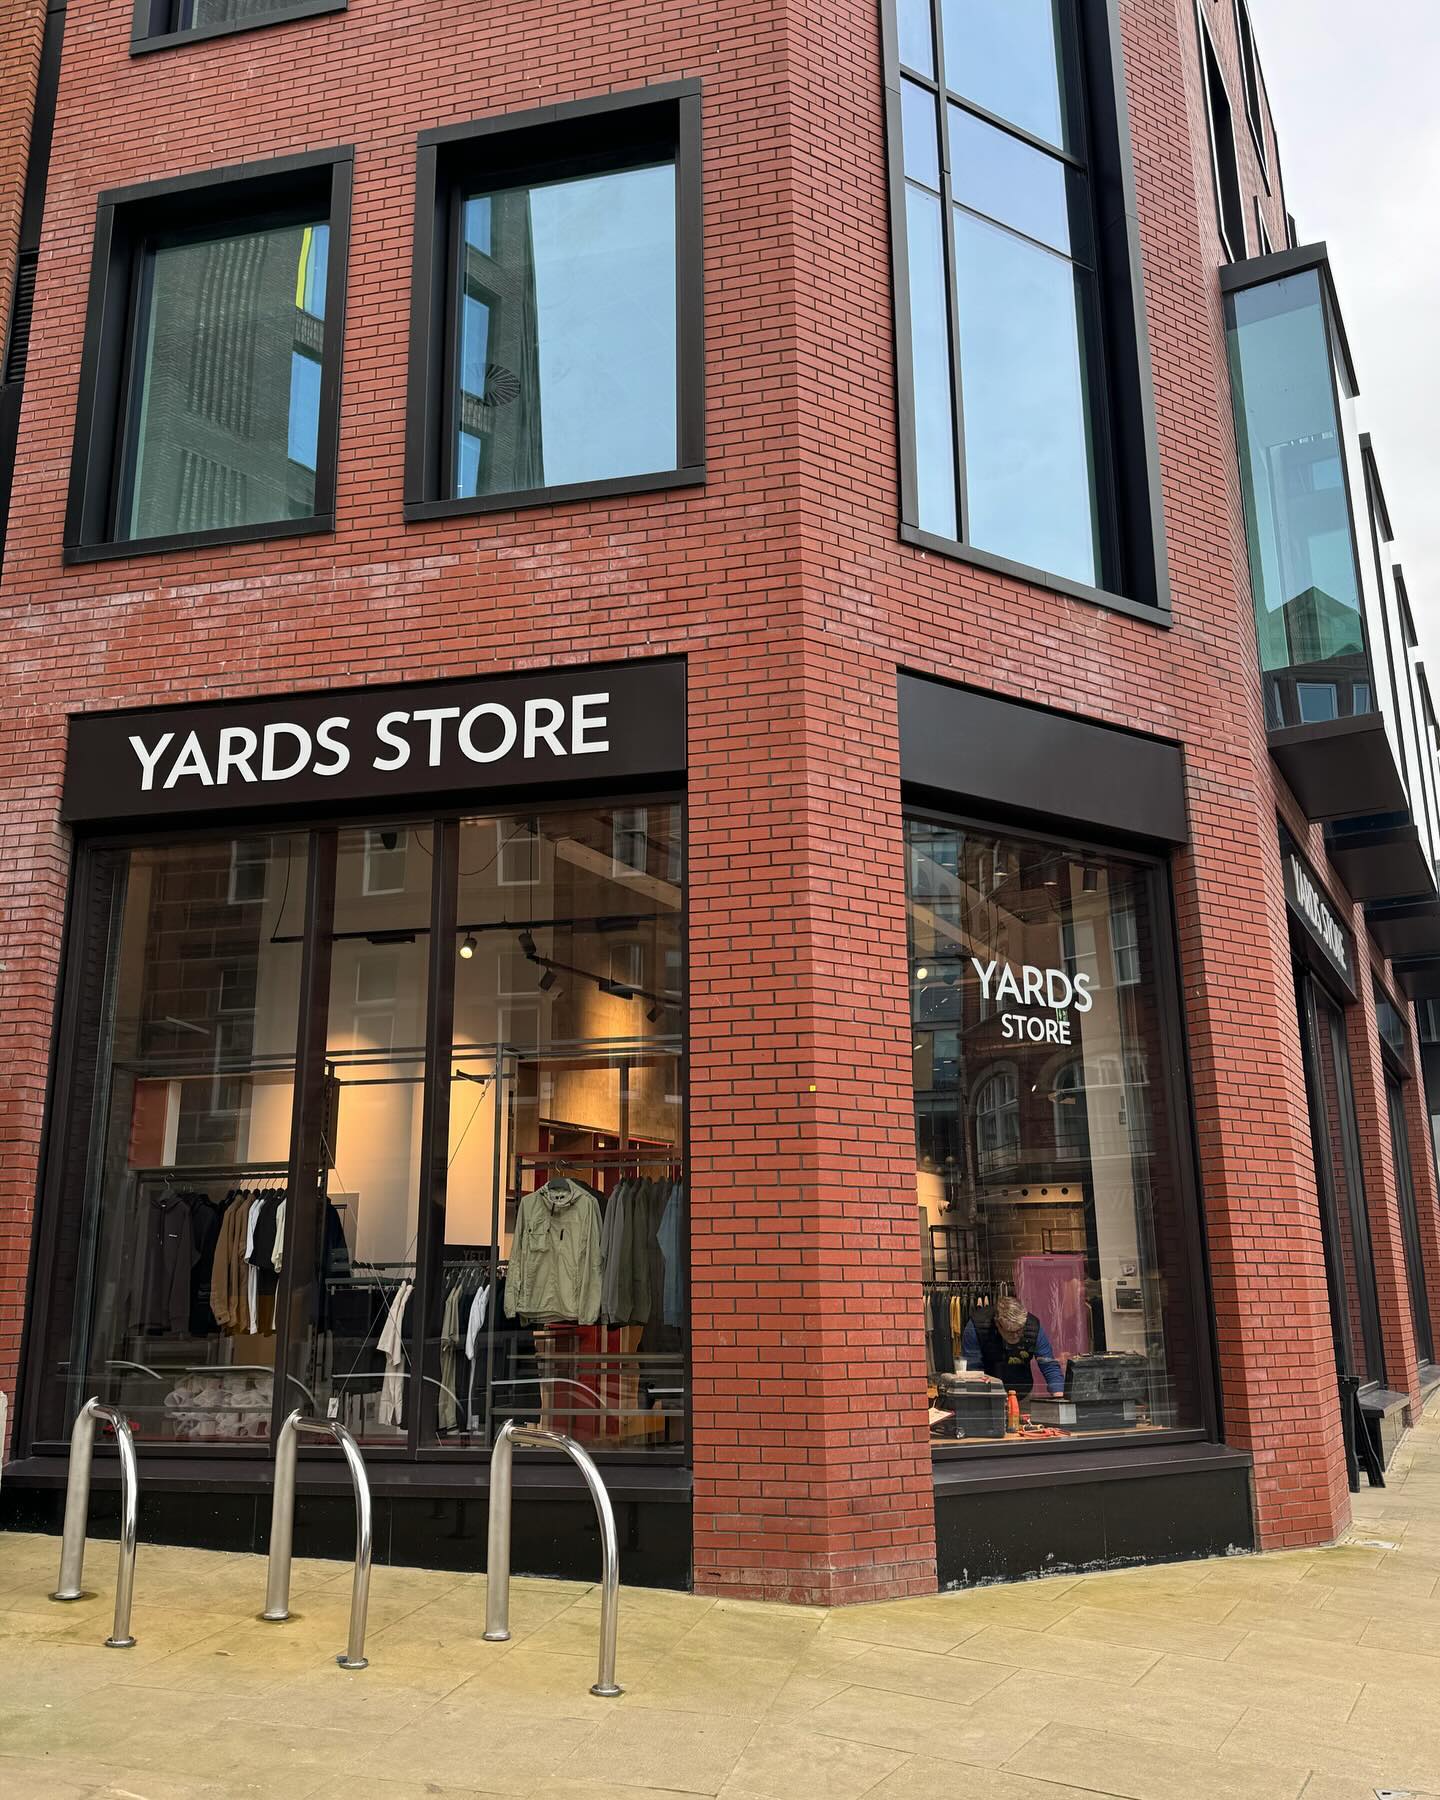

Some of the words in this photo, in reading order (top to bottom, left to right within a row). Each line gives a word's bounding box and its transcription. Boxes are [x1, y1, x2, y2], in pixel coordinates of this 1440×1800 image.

[128, 717, 350, 790] YARDS
[373, 693, 610, 770] STORE
[1290, 854, 1322, 935] YARDS
[1320, 902, 1347, 971] STORE
[970, 957, 1093, 1013] YARDS
[1001, 1014, 1073, 1046] STORE
